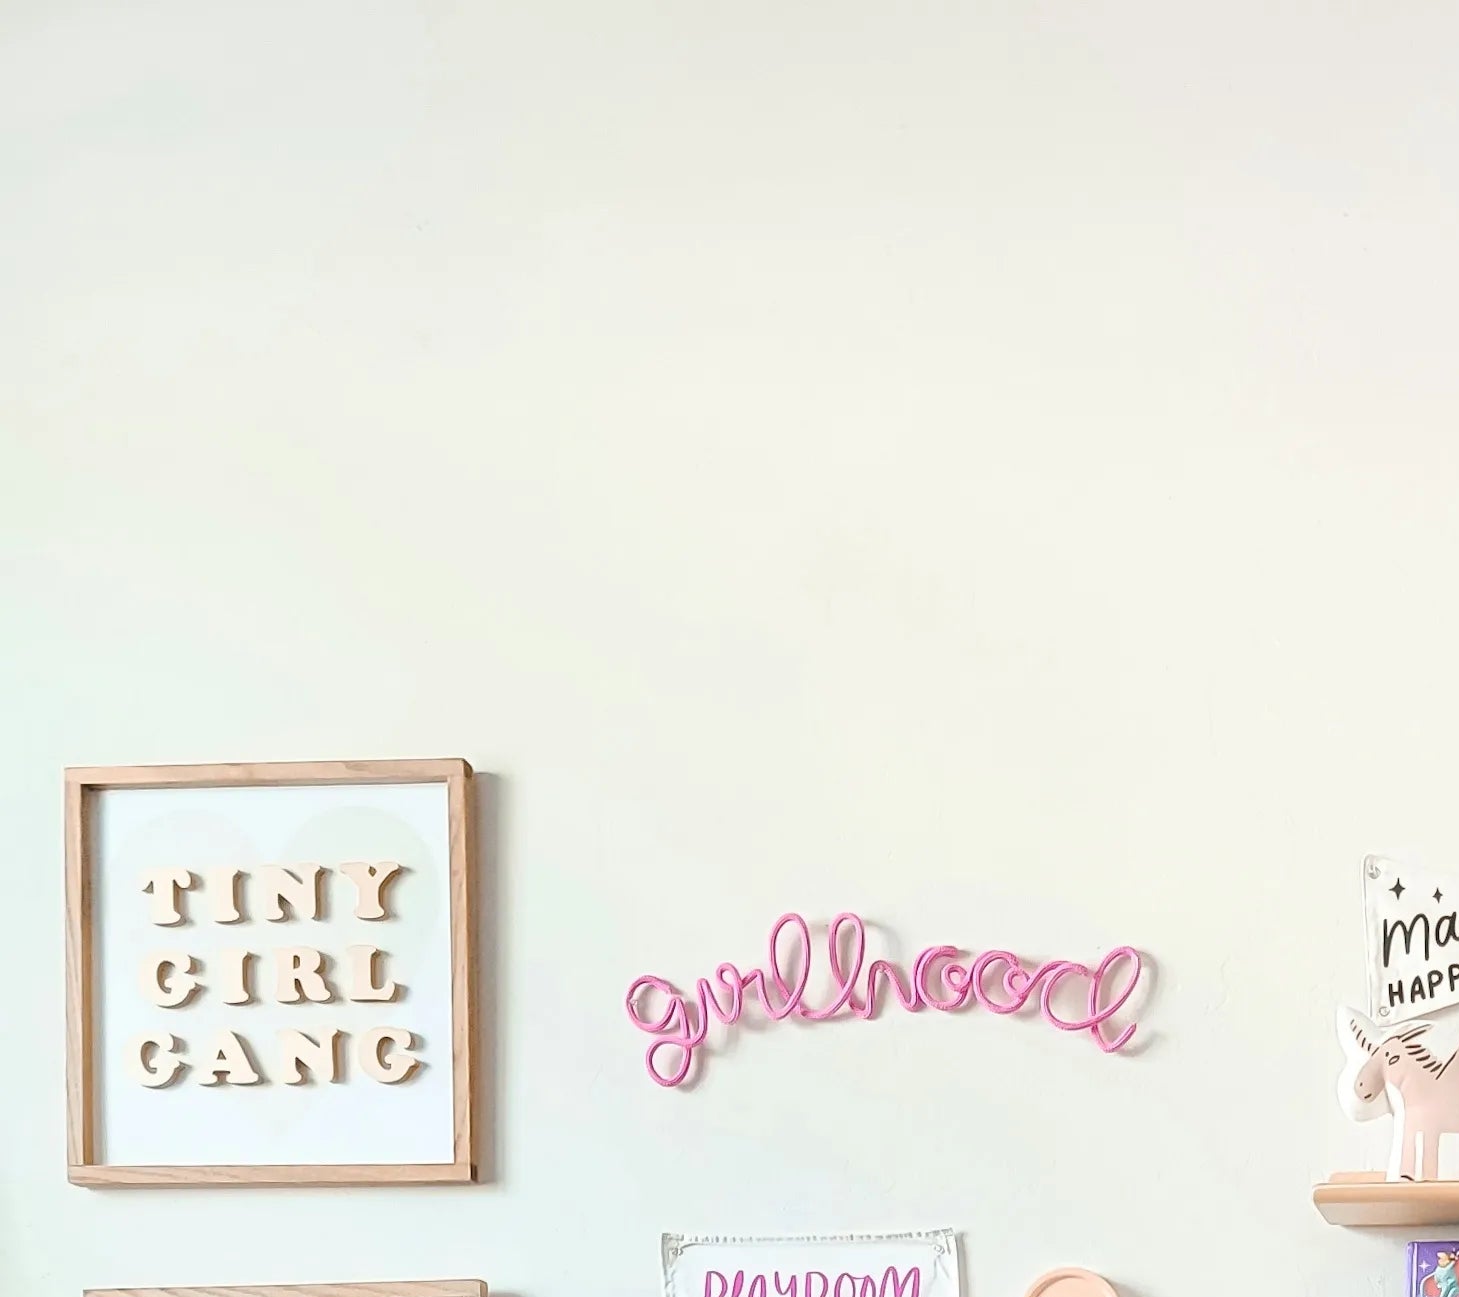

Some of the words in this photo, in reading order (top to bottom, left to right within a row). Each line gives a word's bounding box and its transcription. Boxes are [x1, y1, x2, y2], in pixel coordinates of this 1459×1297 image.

[141, 862, 403, 926] TINY
[138, 944, 399, 1008] GIRL
[626, 912, 1141, 1086] girlhood
[121, 1026, 422, 1087] GANG
